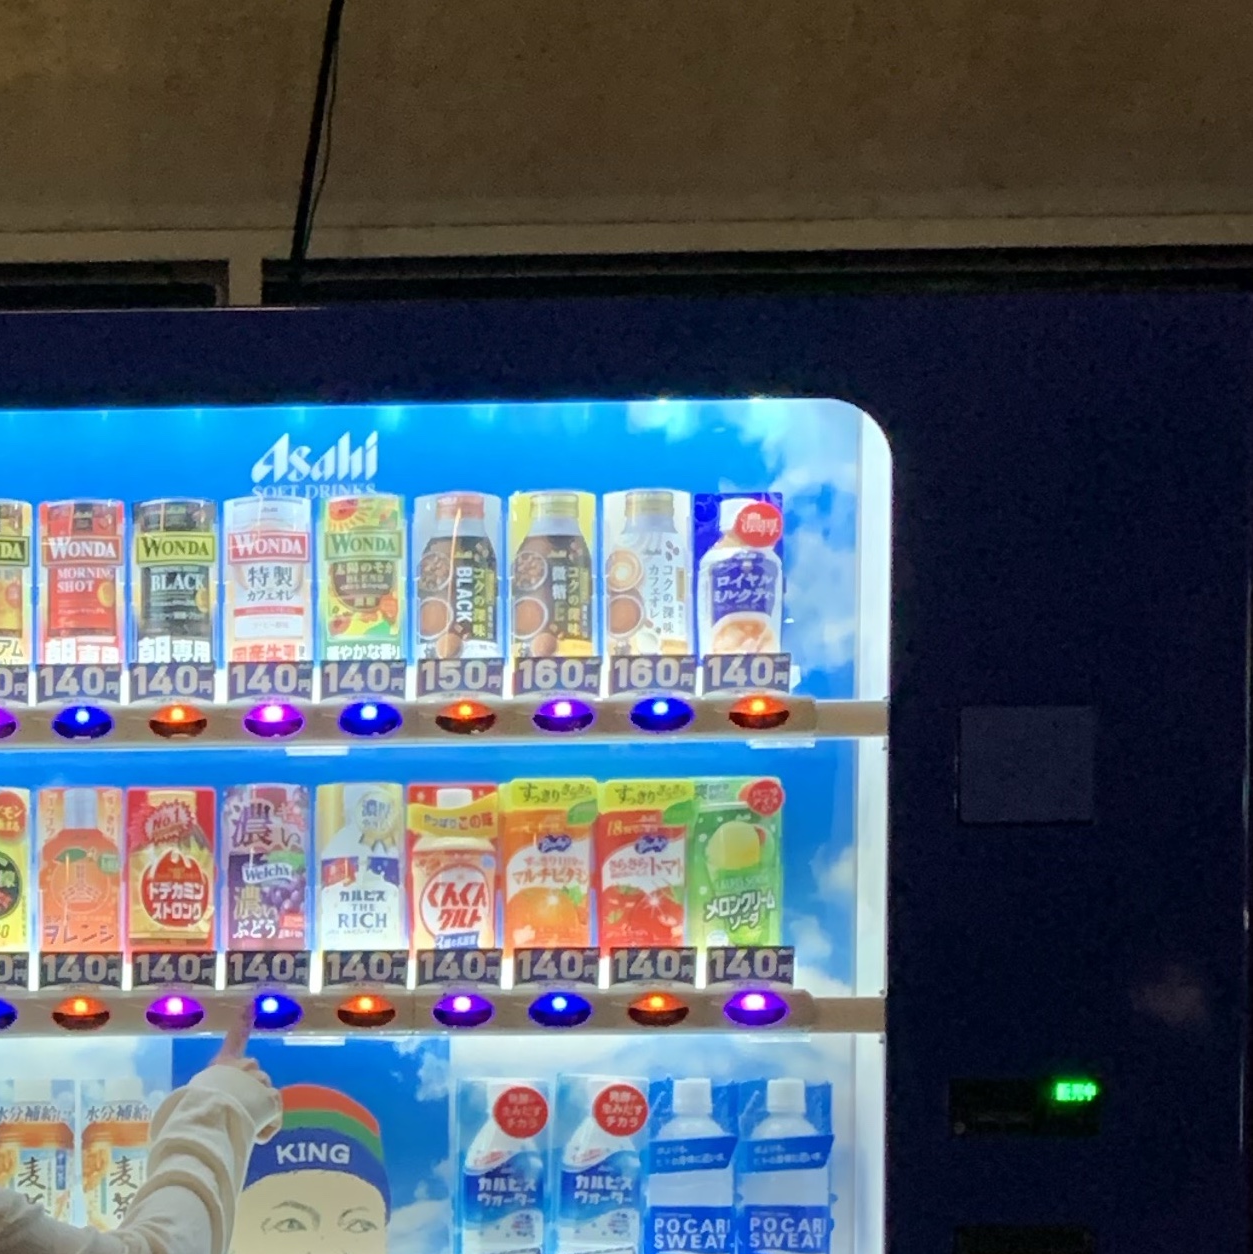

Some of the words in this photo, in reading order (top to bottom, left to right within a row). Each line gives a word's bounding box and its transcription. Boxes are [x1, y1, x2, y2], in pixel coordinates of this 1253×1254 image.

[251, 431, 378, 483] Asahi
[48, 537, 116, 560] WONDA
[142, 536, 209, 557] WONDA
[234, 535, 303, 556] WONDA
[332, 533, 396, 552] WONDA
[151, 573, 205, 591] BLACK
[248, 565, 293, 588] 特製
[717, 575, 773, 588] ロイヤル
[57, 581, 94, 593] SHOT
[247, 590, 295, 602] カフェオレ
[455, 566, 473, 624] BLACK
[648, 565, 660, 620] カフェオレ
[714, 588, 775, 604] ミルクティー
[138, 637, 211, 663] 朝専用
[519, 783, 560, 803] すっきり
[615, 784, 656, 805] すっきり
[230, 802, 302, 849] 濃い
[242, 863, 293, 882] Welch's
[513, 868, 588, 885] マルチビタミン
[148, 881, 204, 900] ドデカミン
[339, 890, 386, 902] カルピス
[151, 902, 203, 920] ストロング
[233, 886, 278, 919] 濃い
[351, 903, 376, 912] THE
[704, 892, 776, 919] メロンクリーム
[338, 912, 387, 929] RICH
[435, 908, 482, 930] グルト
[729, 910, 760, 928] ソーダ
[232, 919, 276, 939] ぶどう
[607, 1116, 638, 1128] チカラ
[276, 1142, 350, 1164] KING
[478, 1175, 536, 1192] カルピス
[575, 1174, 633, 1190] カルピス
[477, 1193, 536, 1206] ウォーター
[574, 1191, 632, 1205] ウォーター
[654, 1218, 731, 1234] POCARI
[749, 1218, 826, 1233] POCARI
[653, 1233, 728, 1249] SWEAT
[748, 1232, 823, 1248] SWEAT
